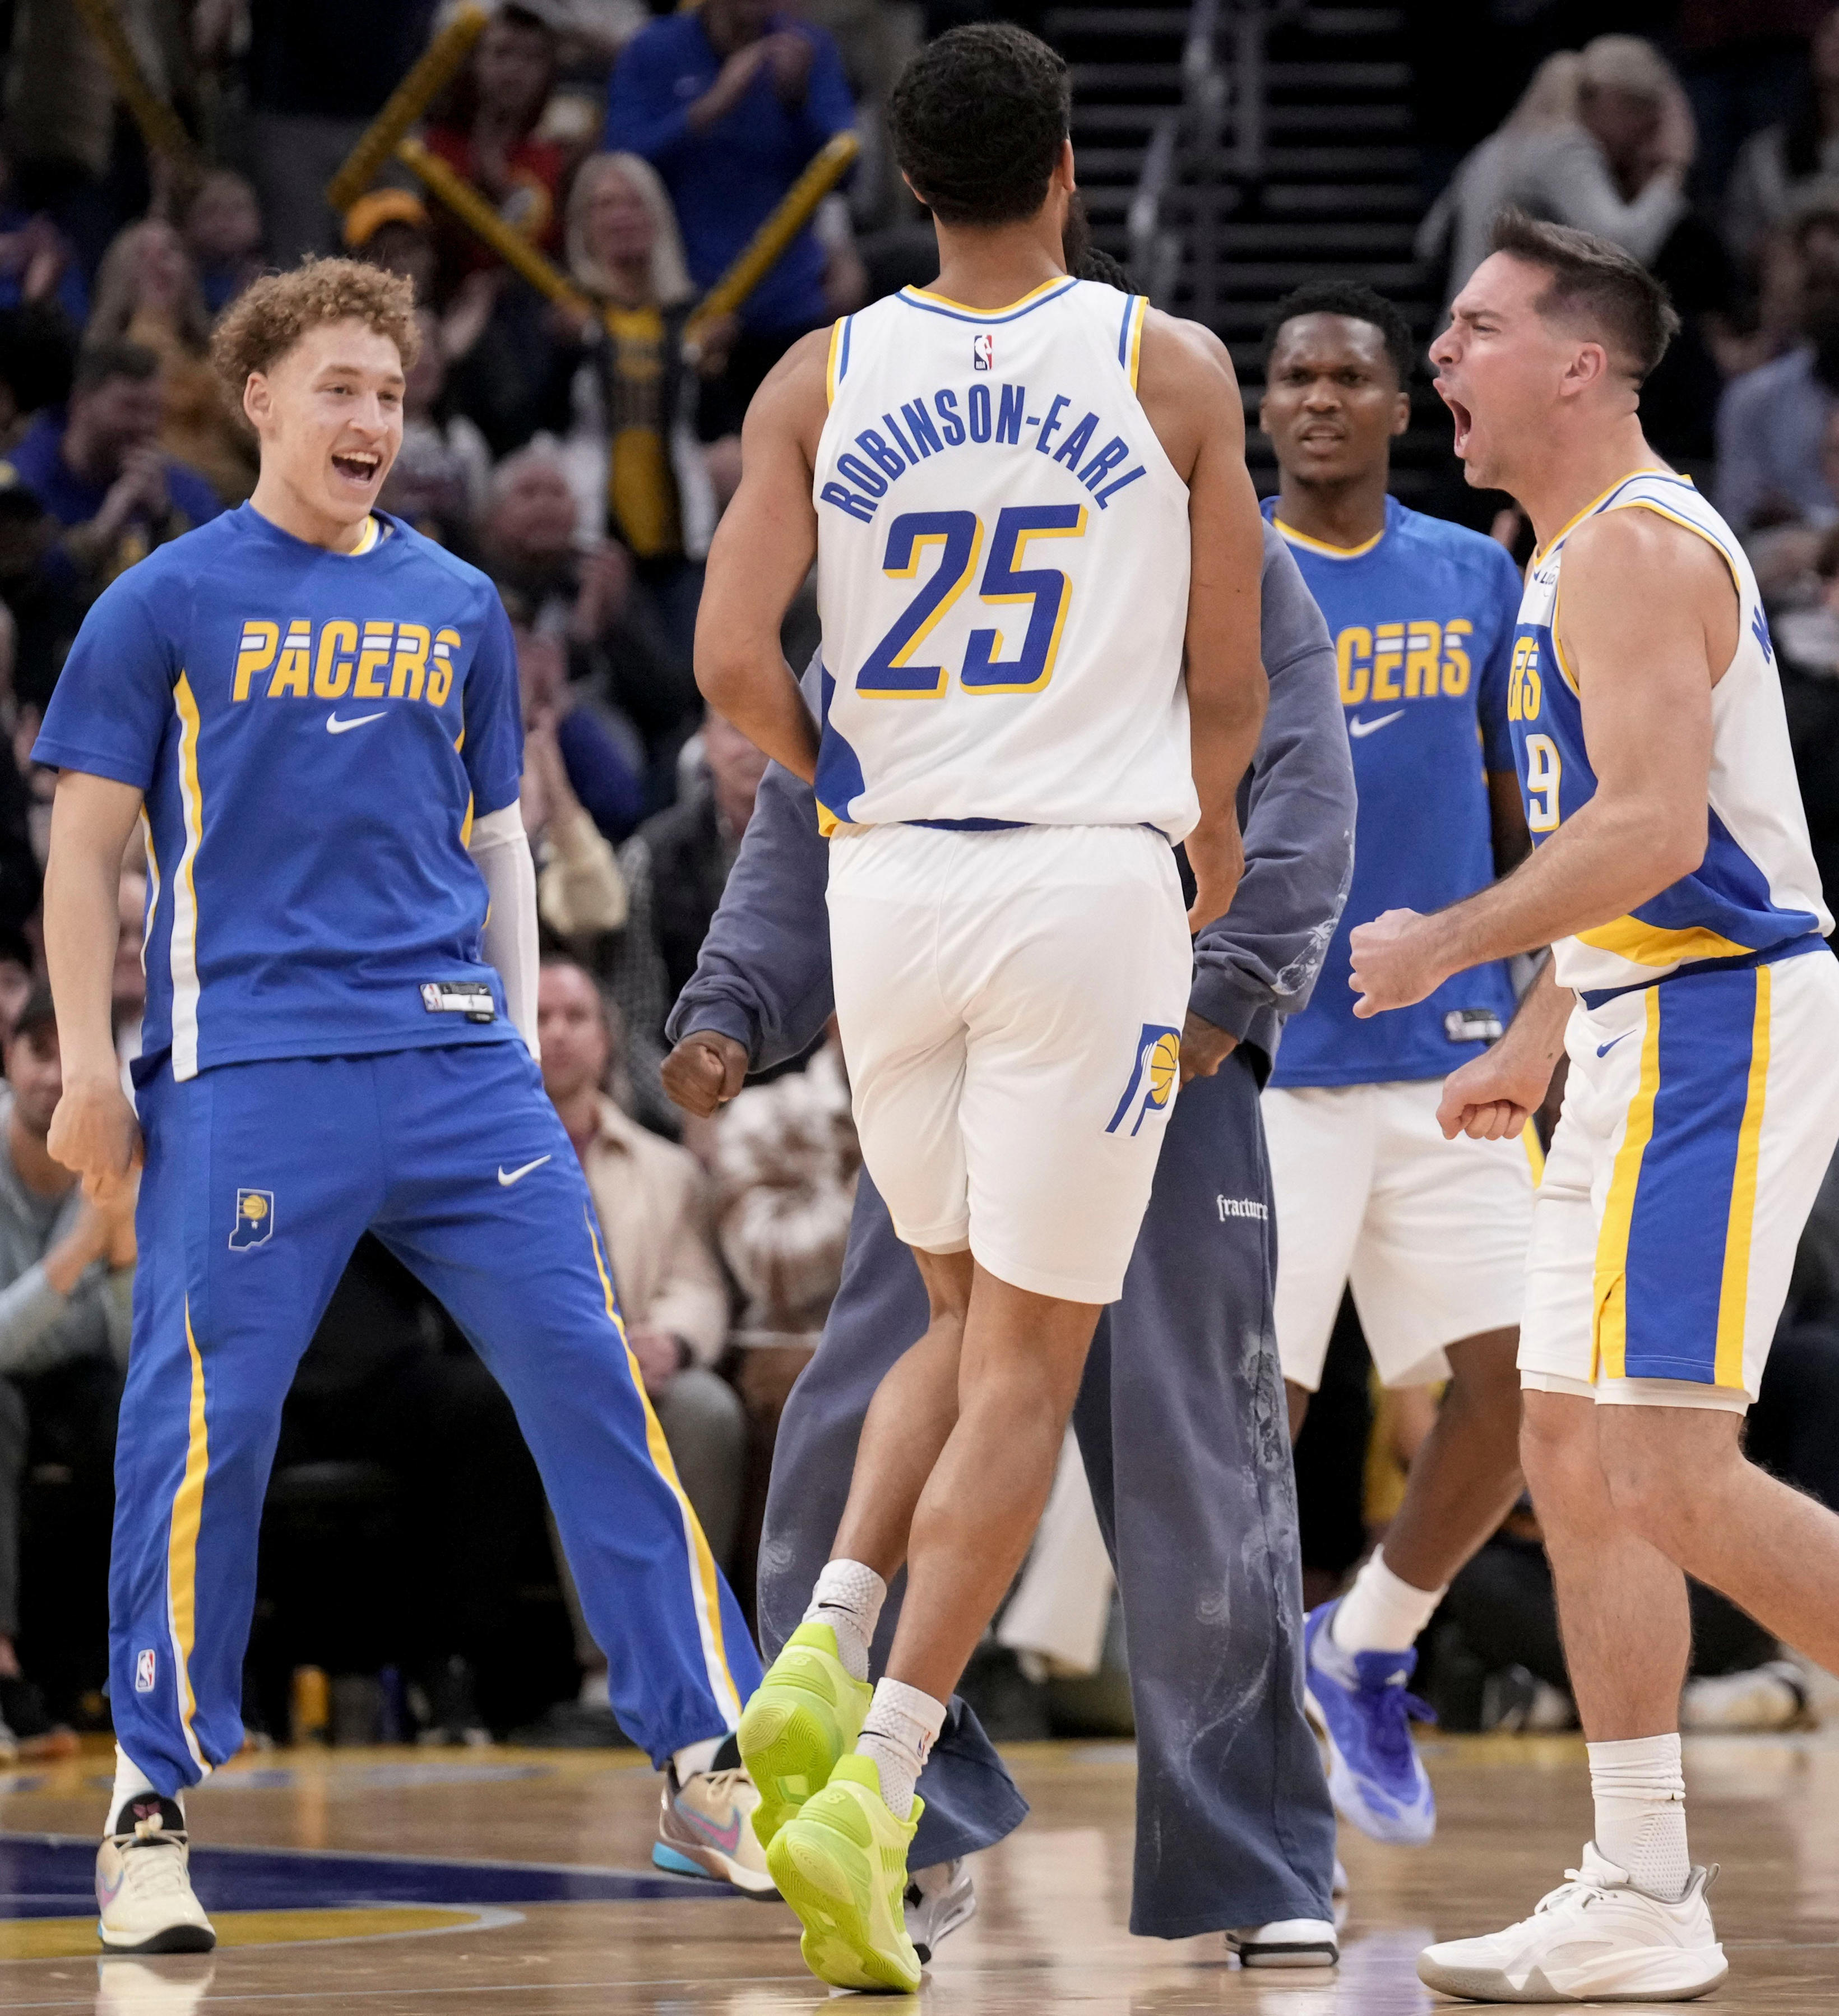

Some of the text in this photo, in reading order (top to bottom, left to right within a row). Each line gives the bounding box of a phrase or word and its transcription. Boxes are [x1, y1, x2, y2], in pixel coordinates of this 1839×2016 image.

[820, 383, 1146, 524] ROBINSON-EARL
[856, 503, 1088, 699] 25
[232, 619, 461, 708] PACERS
[1525, 733, 1562, 833] 9
